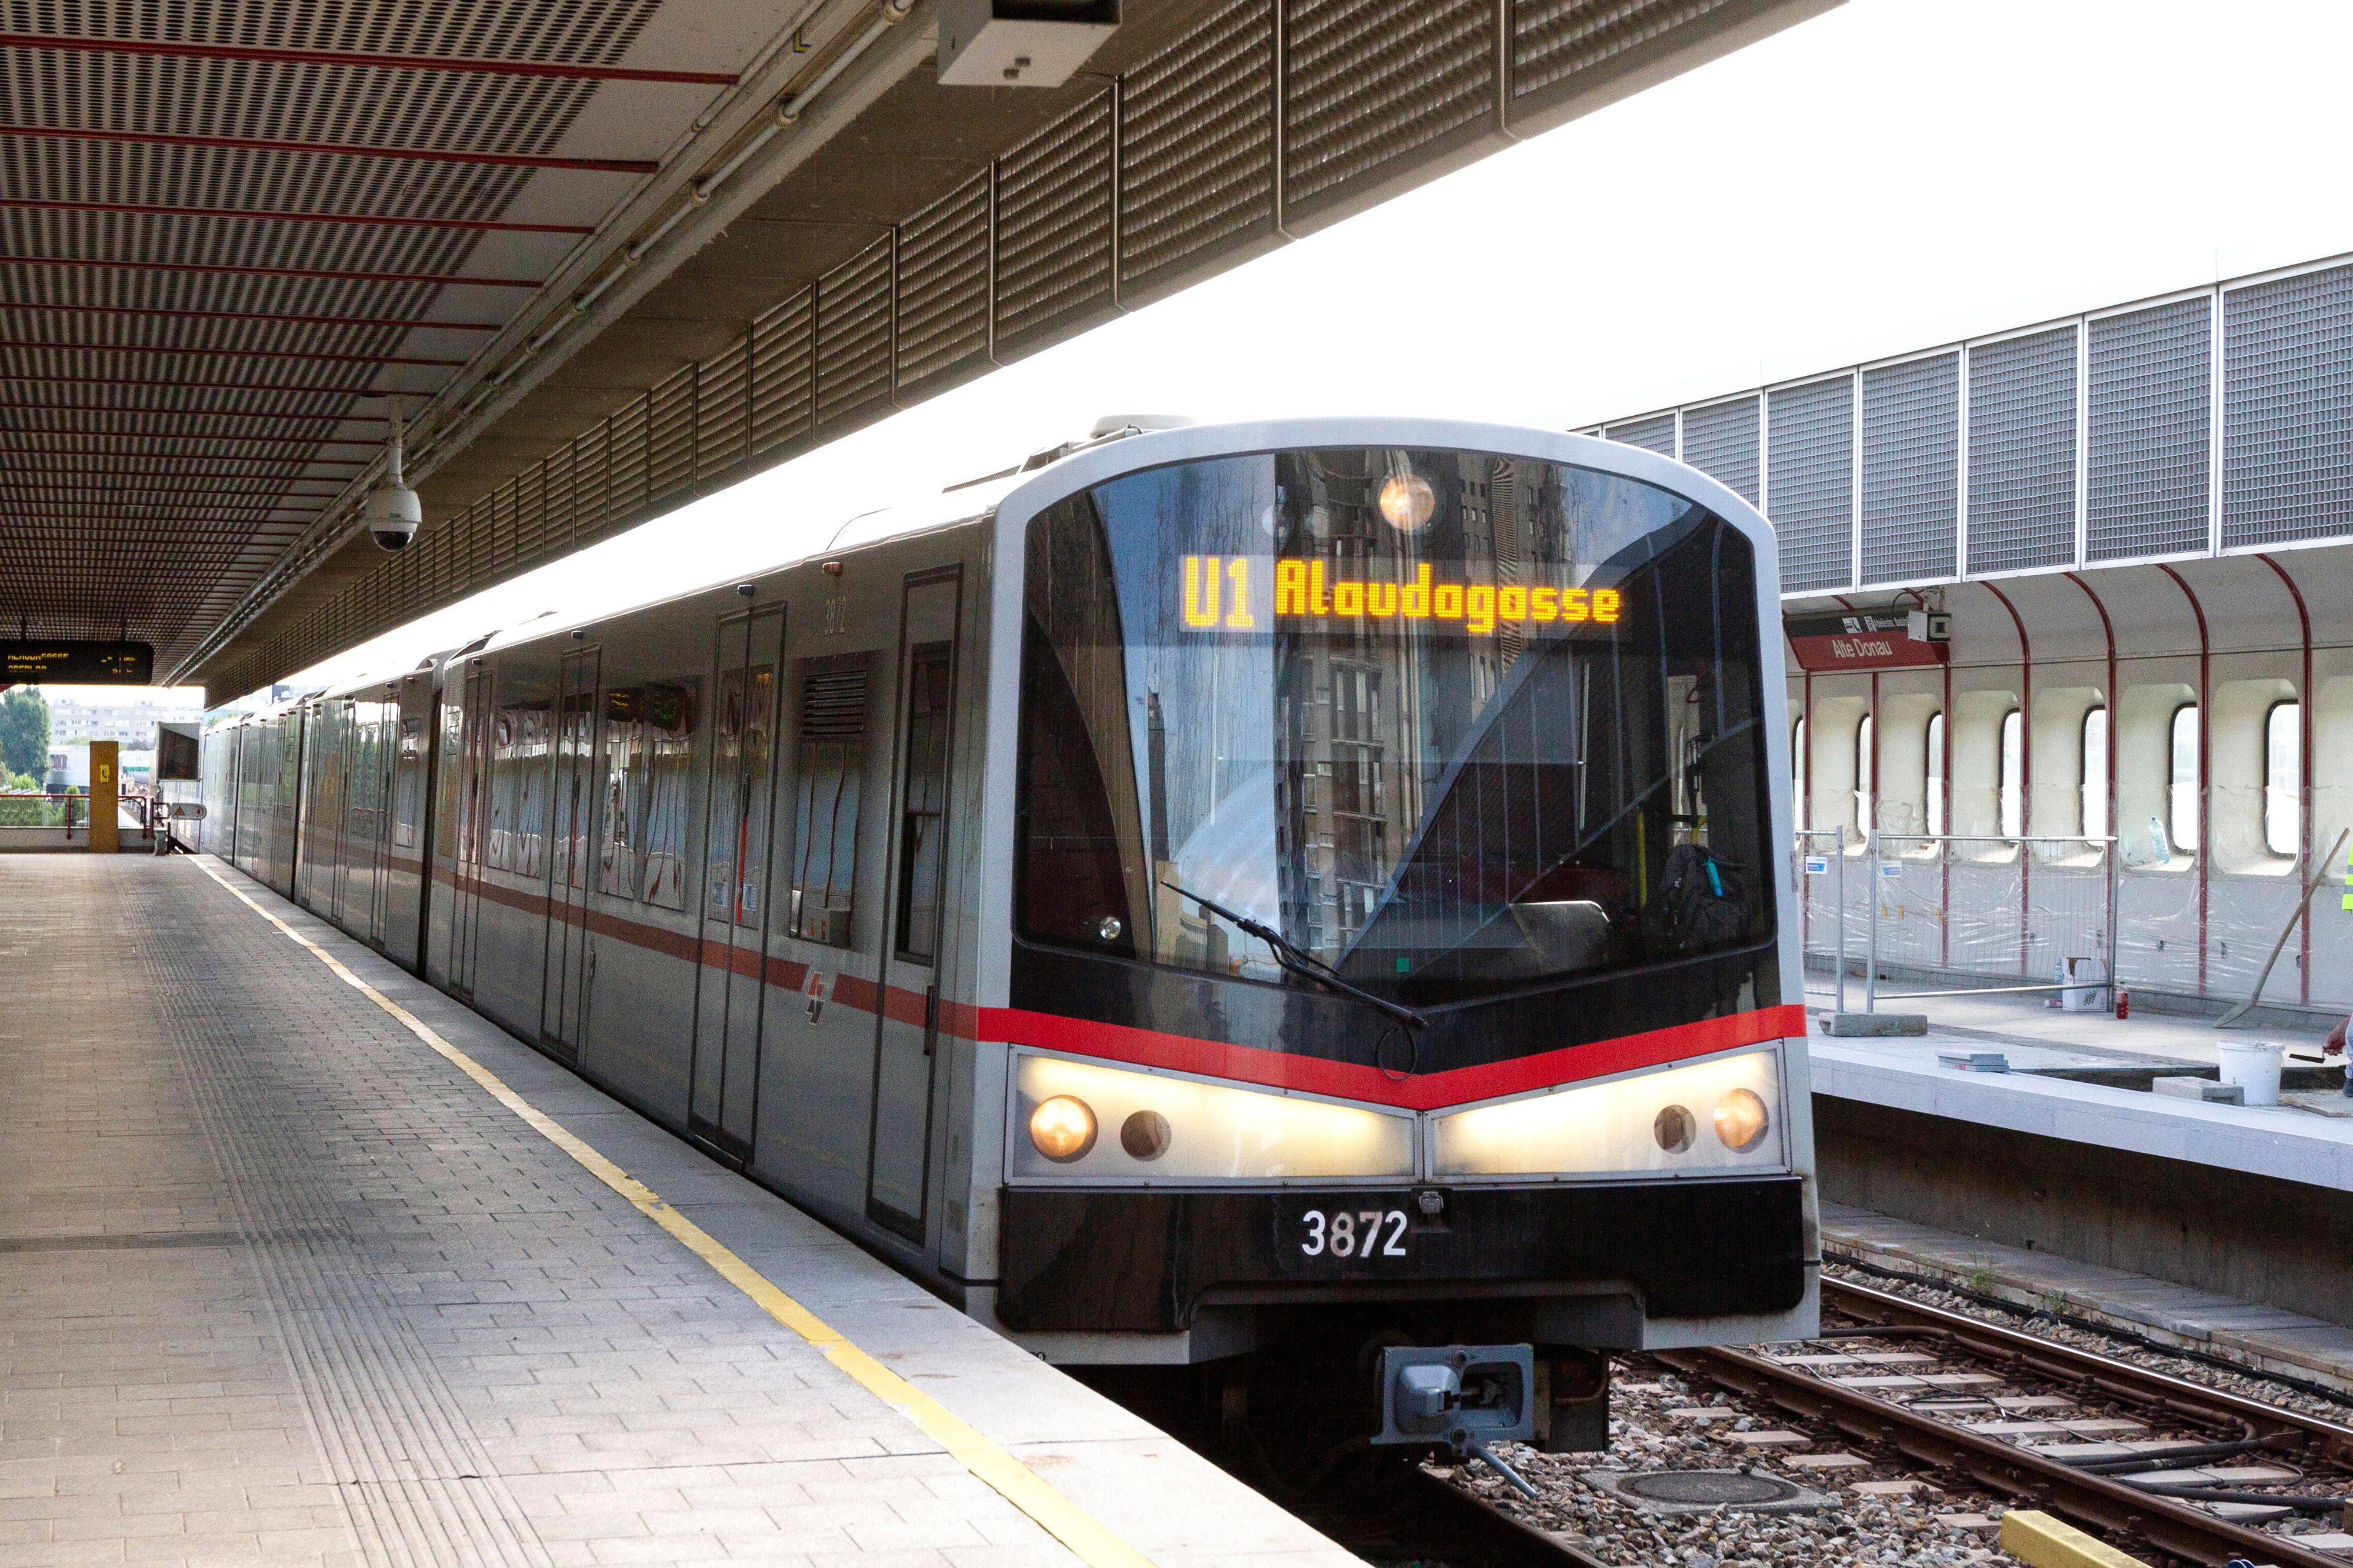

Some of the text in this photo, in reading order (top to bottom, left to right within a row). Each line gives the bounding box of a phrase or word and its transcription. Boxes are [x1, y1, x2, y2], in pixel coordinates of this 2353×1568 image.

[1184, 556, 1622, 633] U1 Alaudagasse
[1832, 638, 1892, 658] Alte Donau
[1301, 1210, 1408, 1257] 3872
